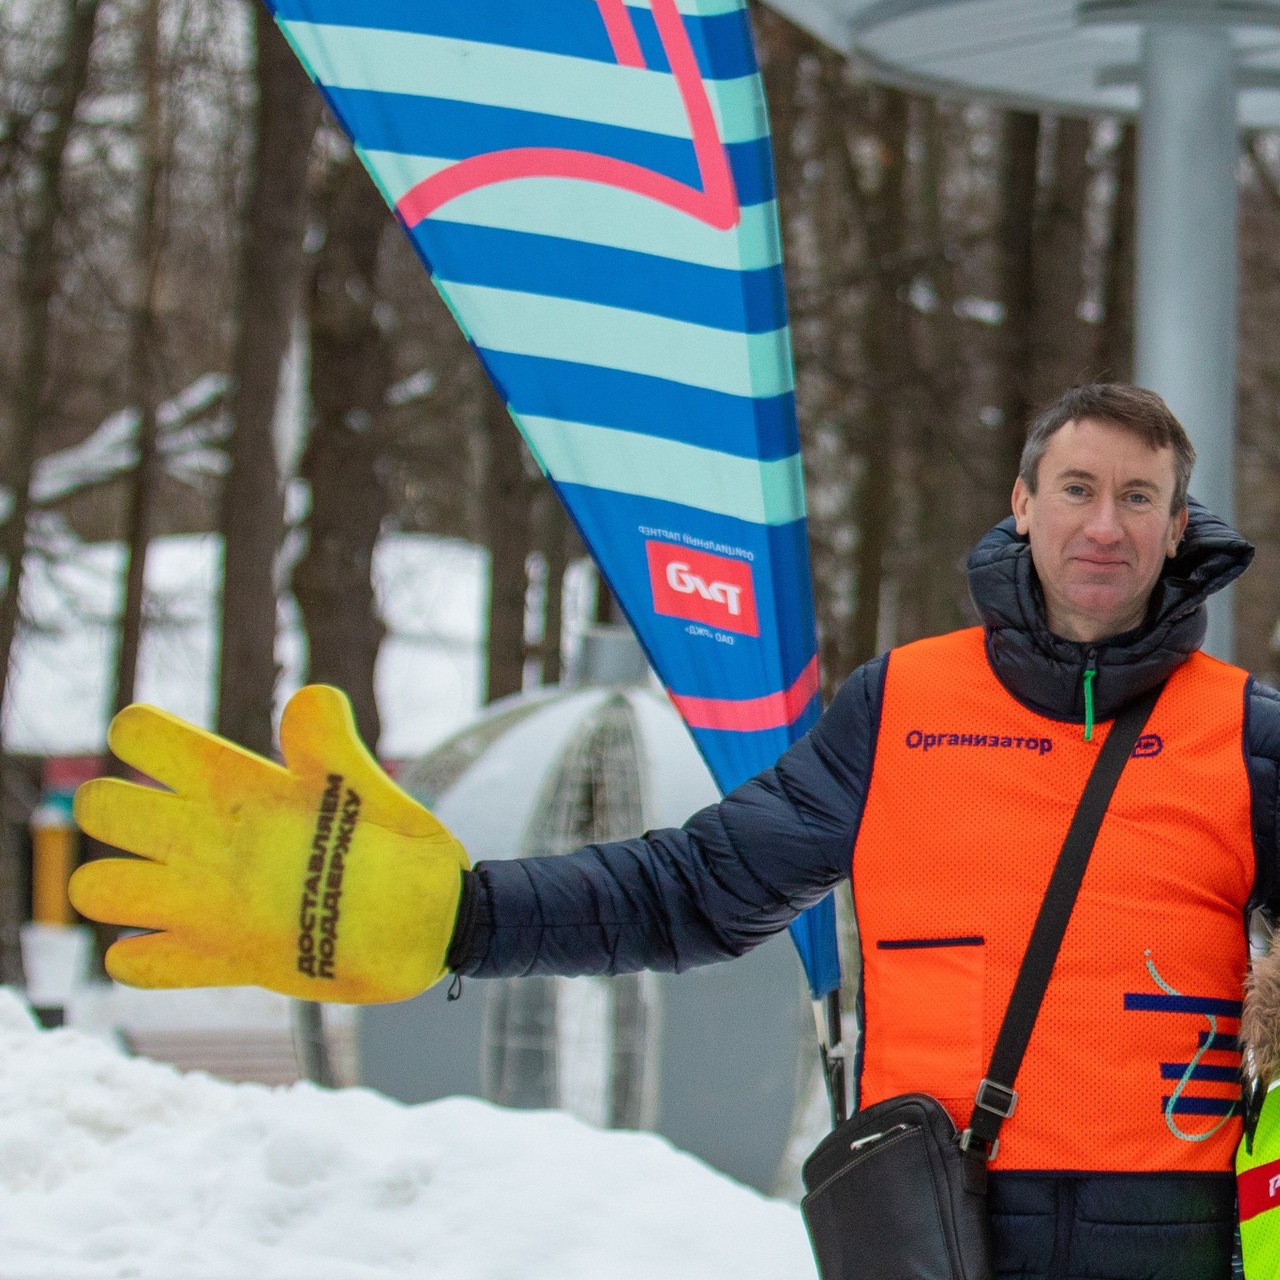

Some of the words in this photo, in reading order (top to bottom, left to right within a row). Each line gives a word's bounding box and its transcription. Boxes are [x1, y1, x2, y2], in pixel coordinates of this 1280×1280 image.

[905, 730, 1053, 756] Организатор
[297, 773, 343, 978] ДОСТАВЛЯЕМ
[318, 788, 361, 979] ПОДДЕРЖКУ
